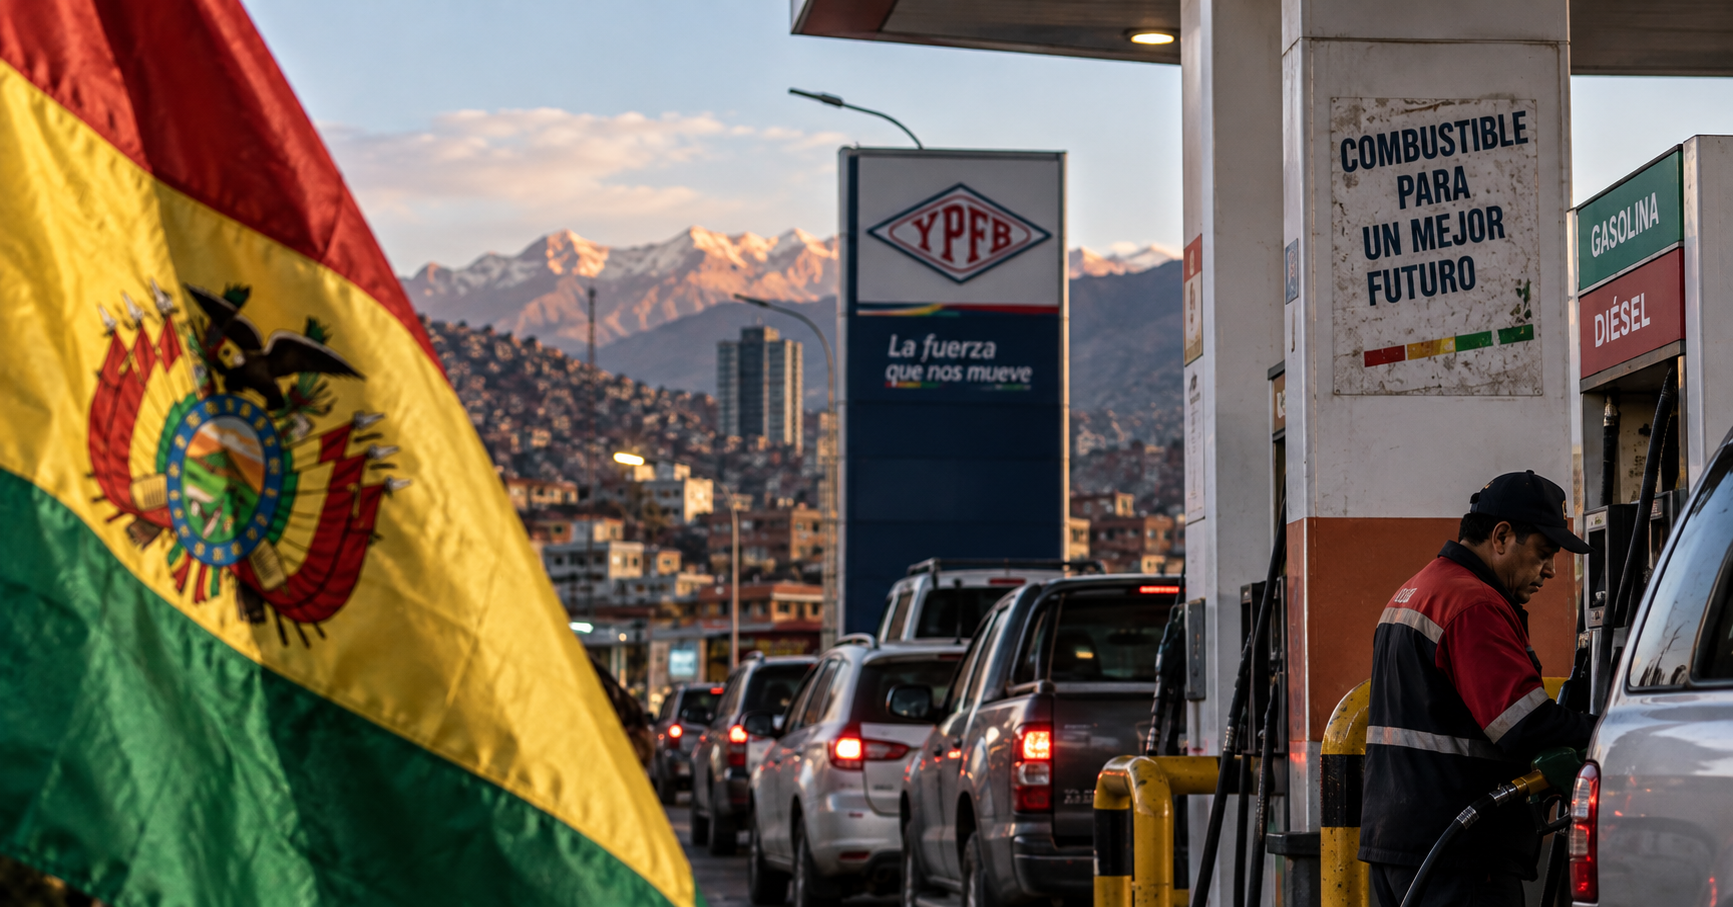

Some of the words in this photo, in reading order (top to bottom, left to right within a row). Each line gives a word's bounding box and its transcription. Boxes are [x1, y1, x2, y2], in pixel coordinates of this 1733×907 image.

[1340, 110, 1529, 173] COMBUSTIBLE
[1397, 165, 1471, 210] PARA
[911, 203, 1012, 264] YPFB
[1362, 222, 1402, 260] UN
[1410, 205, 1506, 253] MEJOR
[1591, 192, 1660, 258] GASOLINA
[1367, 255, 1476, 306] FUTURO
[1594, 292, 1651, 348] DIÉSEL
[885, 364, 924, 387] que
[927, 364, 964, 382] nos
[967, 365, 1033, 383] mueve
[888, 334, 916, 358] La
[920, 333, 997, 363] fuerza
